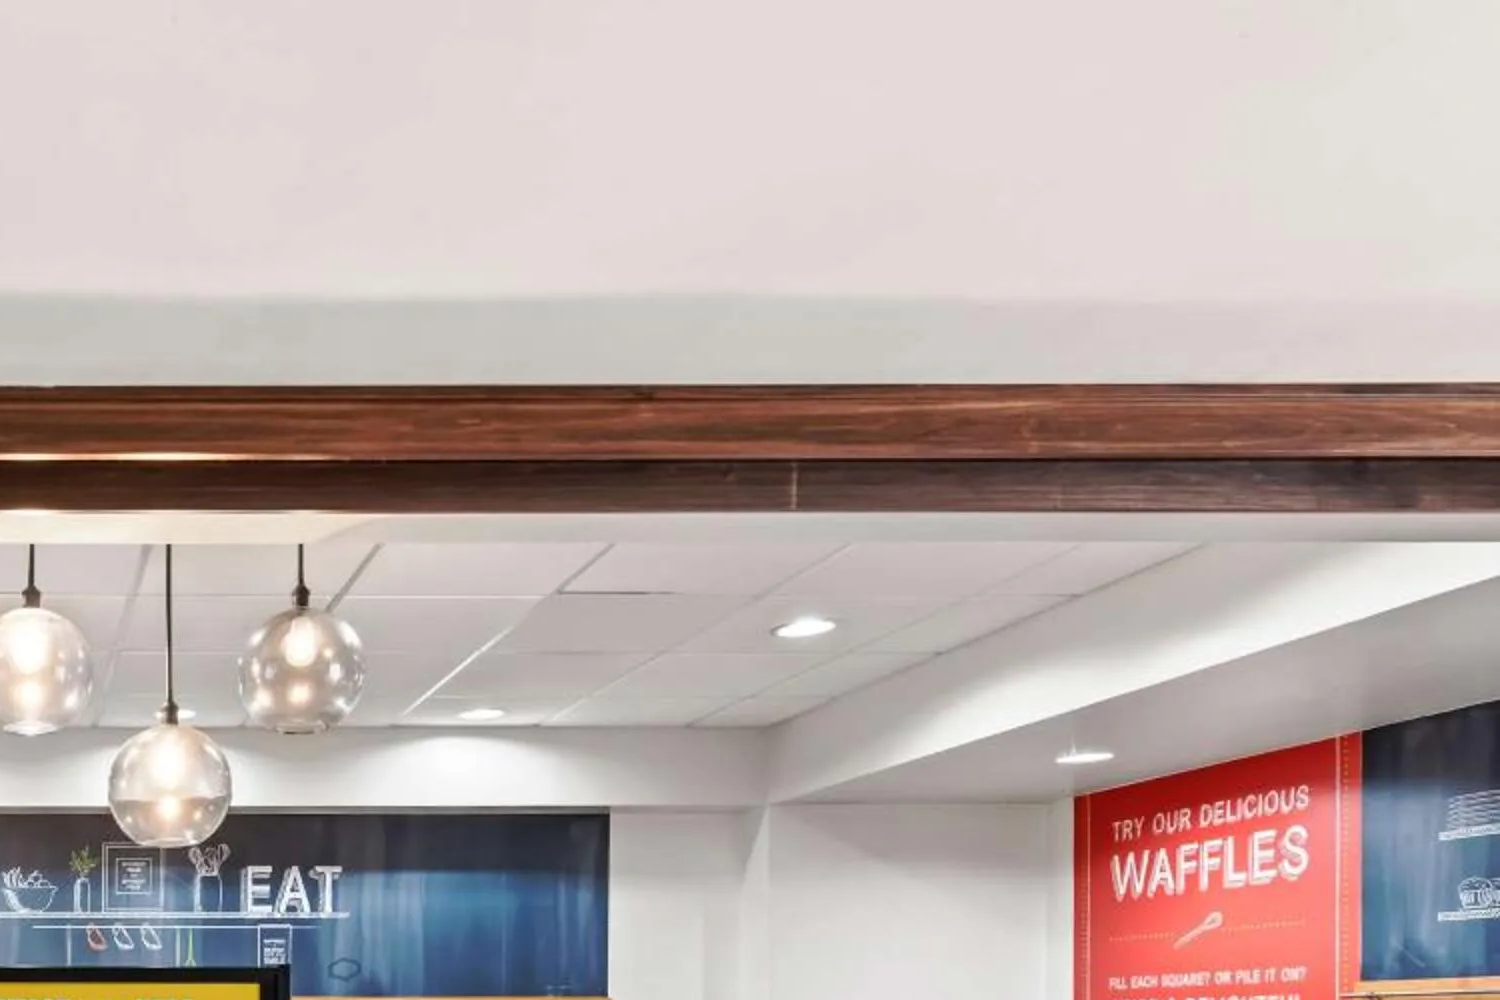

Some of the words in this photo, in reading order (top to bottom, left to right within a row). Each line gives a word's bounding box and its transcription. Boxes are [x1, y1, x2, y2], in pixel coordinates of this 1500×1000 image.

[1111, 815, 1145, 842] TRY
[1152, 807, 1192, 835] OUR
[1199, 784, 1310, 829] DELICIOUS
[239, 865, 343, 913] EAT
[1109, 824, 1310, 903] WAFFLES
[1130, 974, 1159, 989] EACH
[1235, 969, 1261, 985] PILE
[1265, 967, 1276, 984] IT
